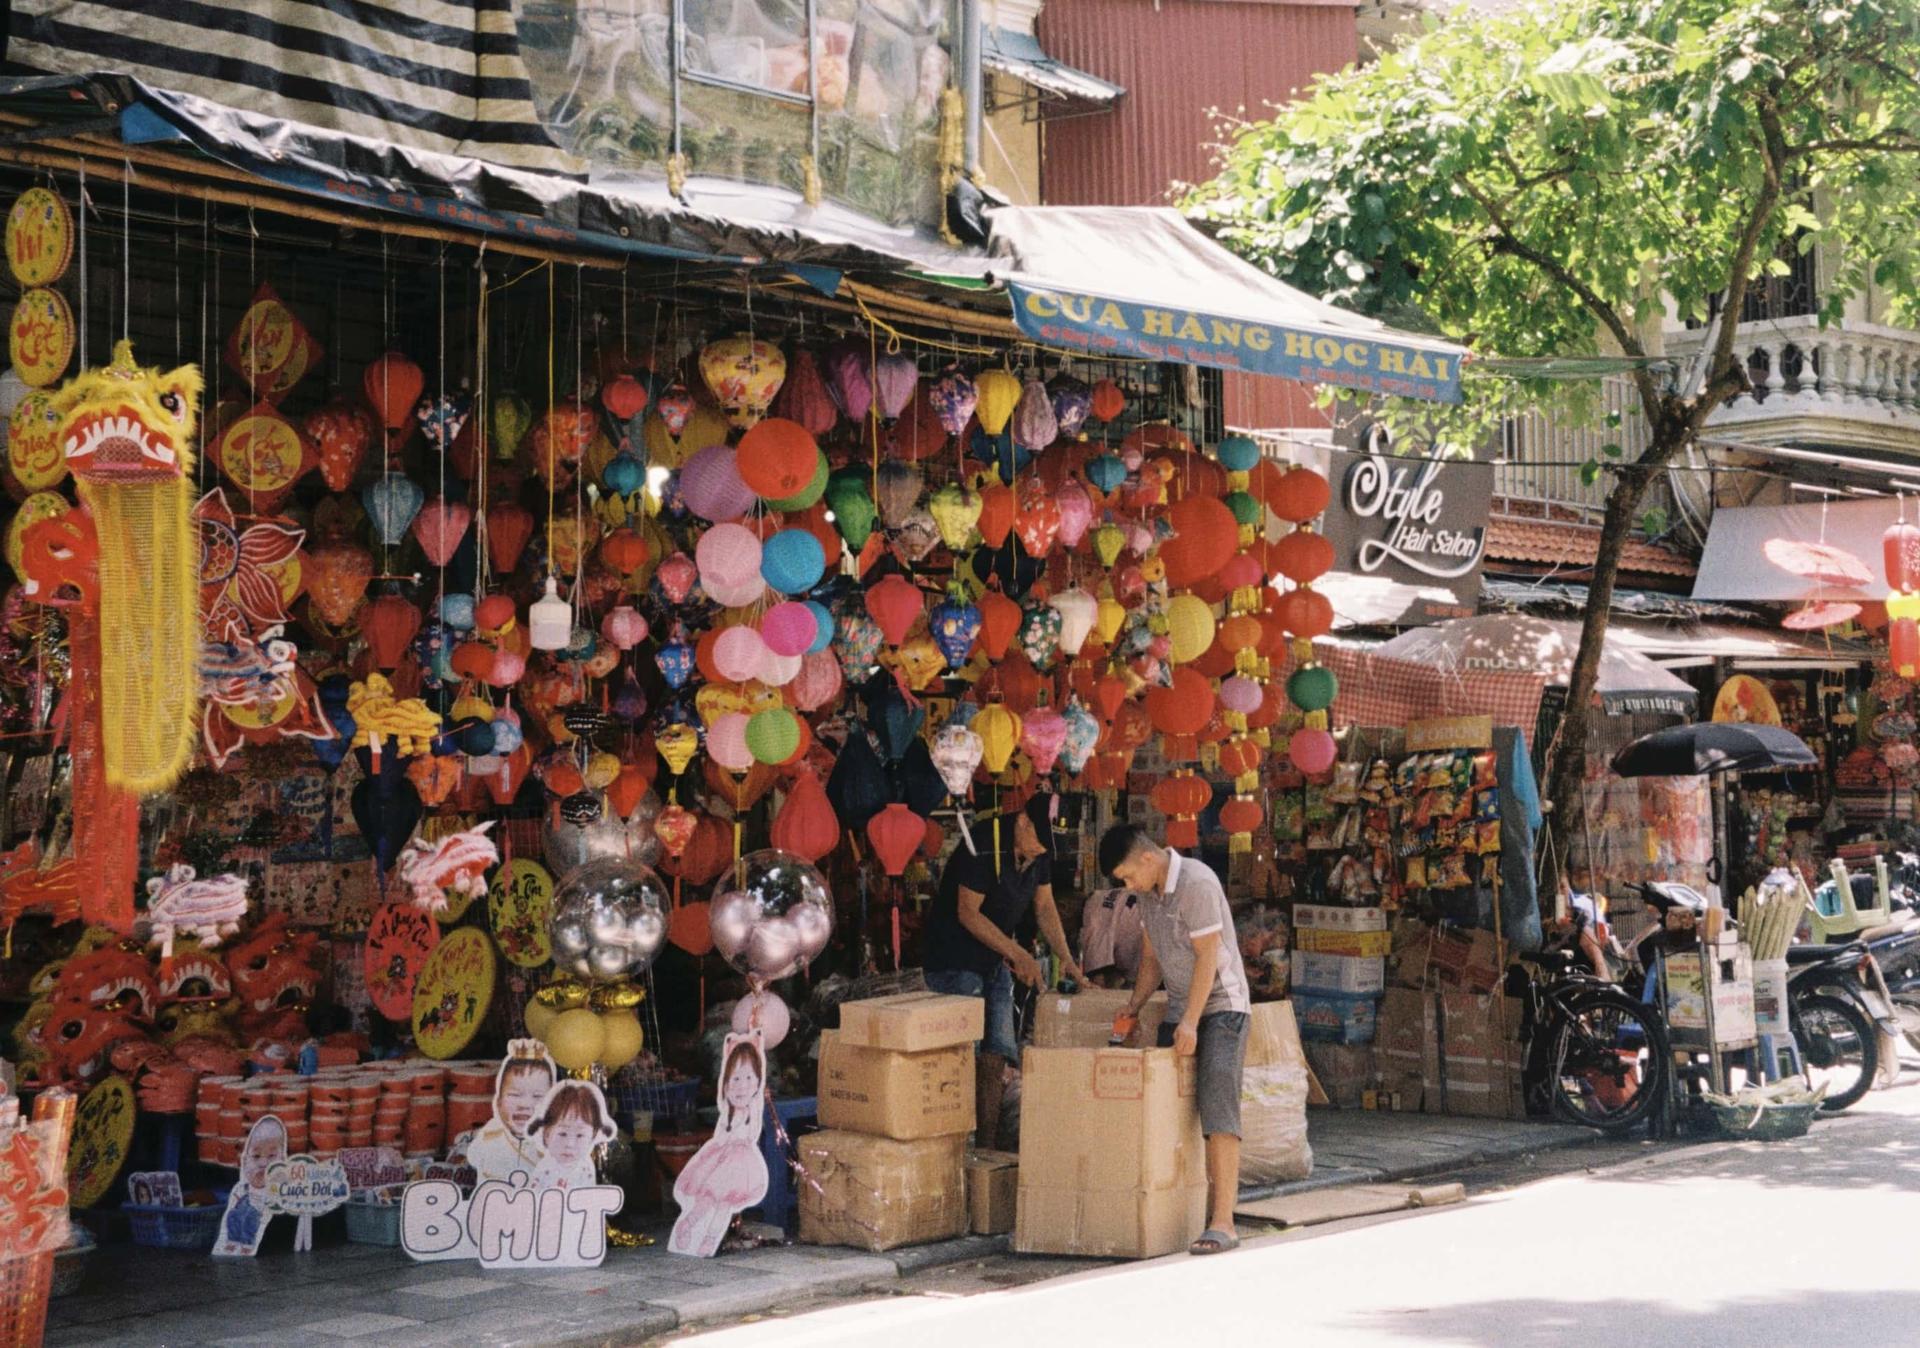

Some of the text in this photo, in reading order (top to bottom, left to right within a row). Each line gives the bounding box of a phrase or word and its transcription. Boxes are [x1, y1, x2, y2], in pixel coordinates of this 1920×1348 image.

[1285, 333, 1368, 367] HỌC
[1395, 526, 1477, 557] Hair Salon
[279, 1181, 309, 1199] Cuộc
